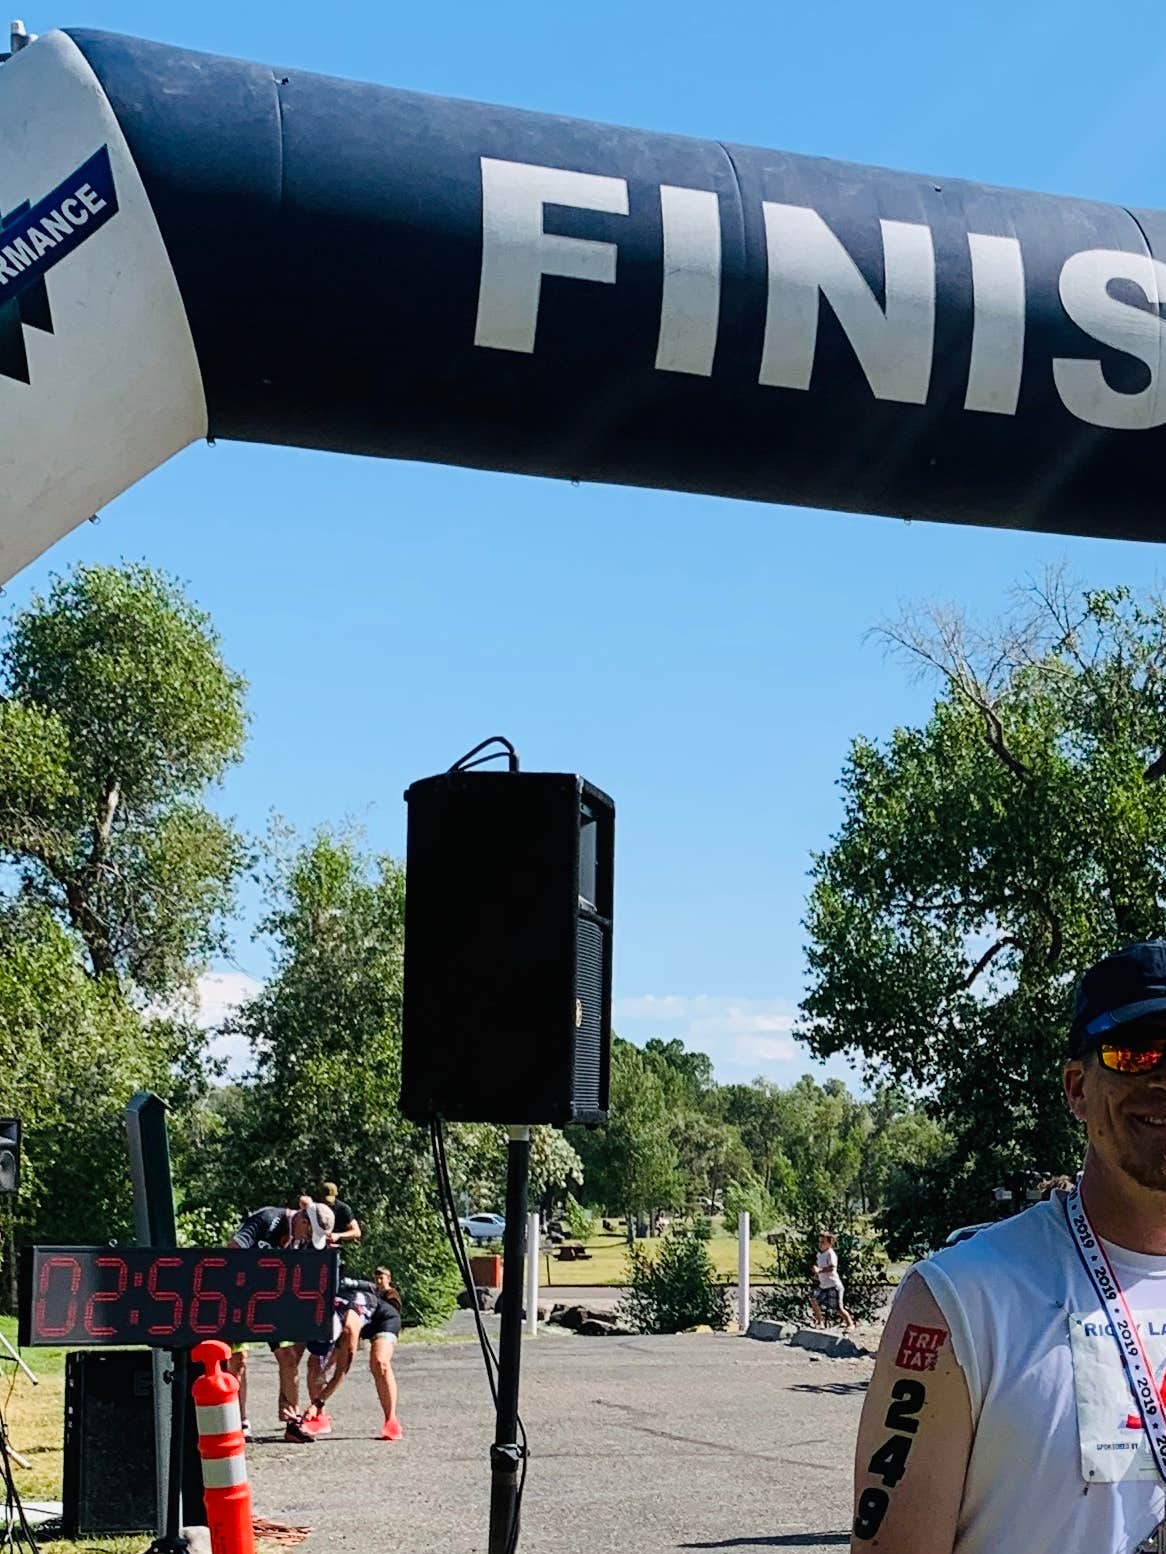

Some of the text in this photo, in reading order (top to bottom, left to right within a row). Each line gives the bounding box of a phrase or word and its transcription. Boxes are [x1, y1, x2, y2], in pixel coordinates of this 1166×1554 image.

[35, 1257, 328, 1337] 02:56:24
[906, 1331, 938, 1349] TRI
[1073, 1215, 1095, 1249] 2019
[1094, 1267, 1117, 1300] 2019
[1117, 1320, 1139, 1357] 2019
[1137, 1377, 1157, 1416] 2019
[853, 1379, 926, 1540] 249
